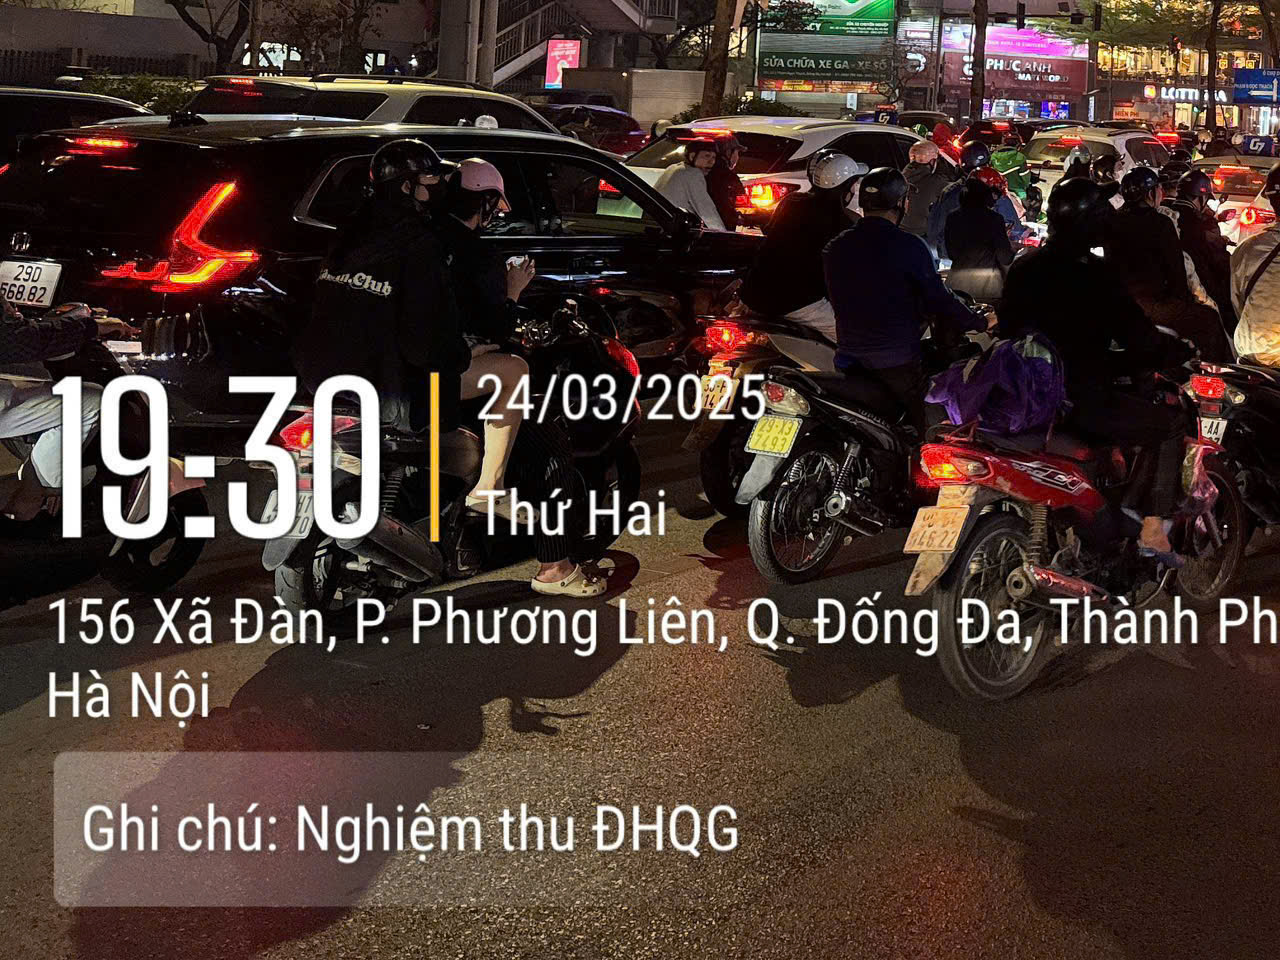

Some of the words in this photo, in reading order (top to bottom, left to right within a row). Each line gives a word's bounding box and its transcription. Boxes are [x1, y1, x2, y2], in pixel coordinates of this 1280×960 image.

[763, 56, 785, 68] SỬA
[787, 57, 815, 69] CHỮA
[818, 60, 832, 68] XE
[834, 60, 850, 69] GA
[857, 61, 871, 70] XE
[1024, 60, 1051, 73] ANH
[1250, 138, 1266, 151] G7
[14, 265, 42, 282] 29D
